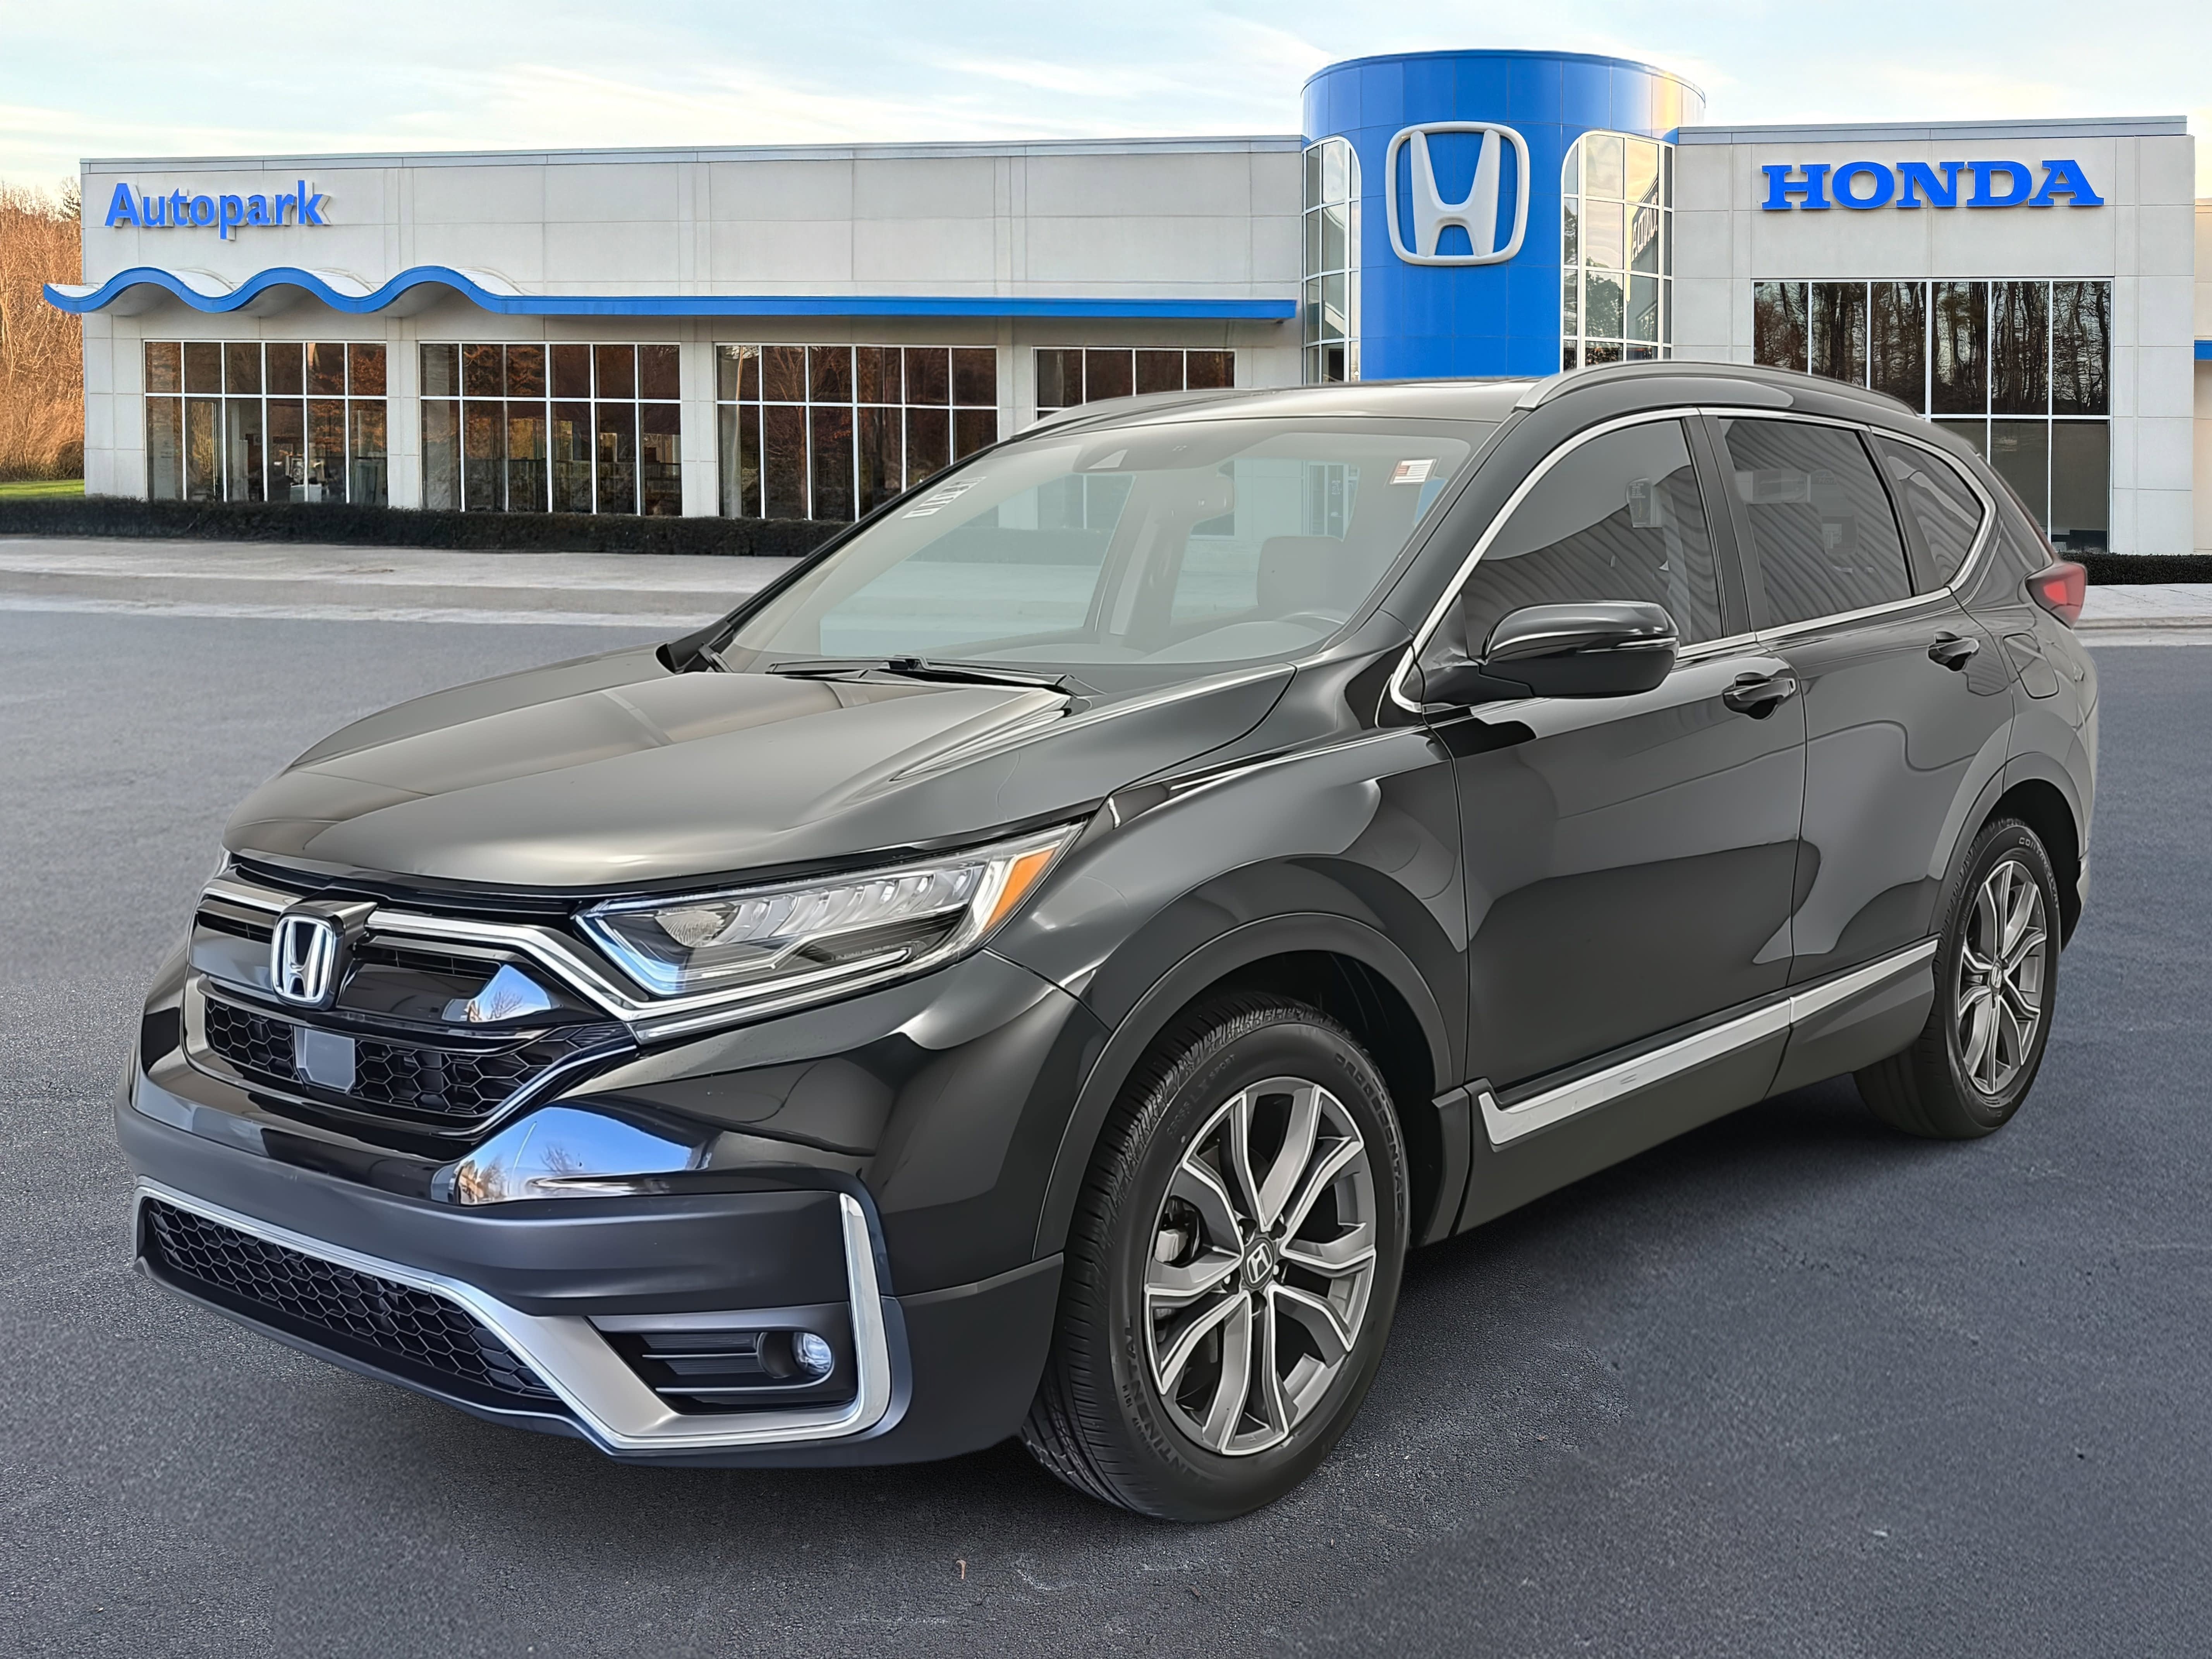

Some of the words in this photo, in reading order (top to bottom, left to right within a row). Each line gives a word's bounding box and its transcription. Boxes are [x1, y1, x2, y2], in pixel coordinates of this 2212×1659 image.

[105, 180, 330, 240] Autopark
[1761, 160, 2104, 210] HONDA
[1209, 1054, 1235, 1080] SPORT
[1125, 1316, 1200, 1475] NTINENTAL
